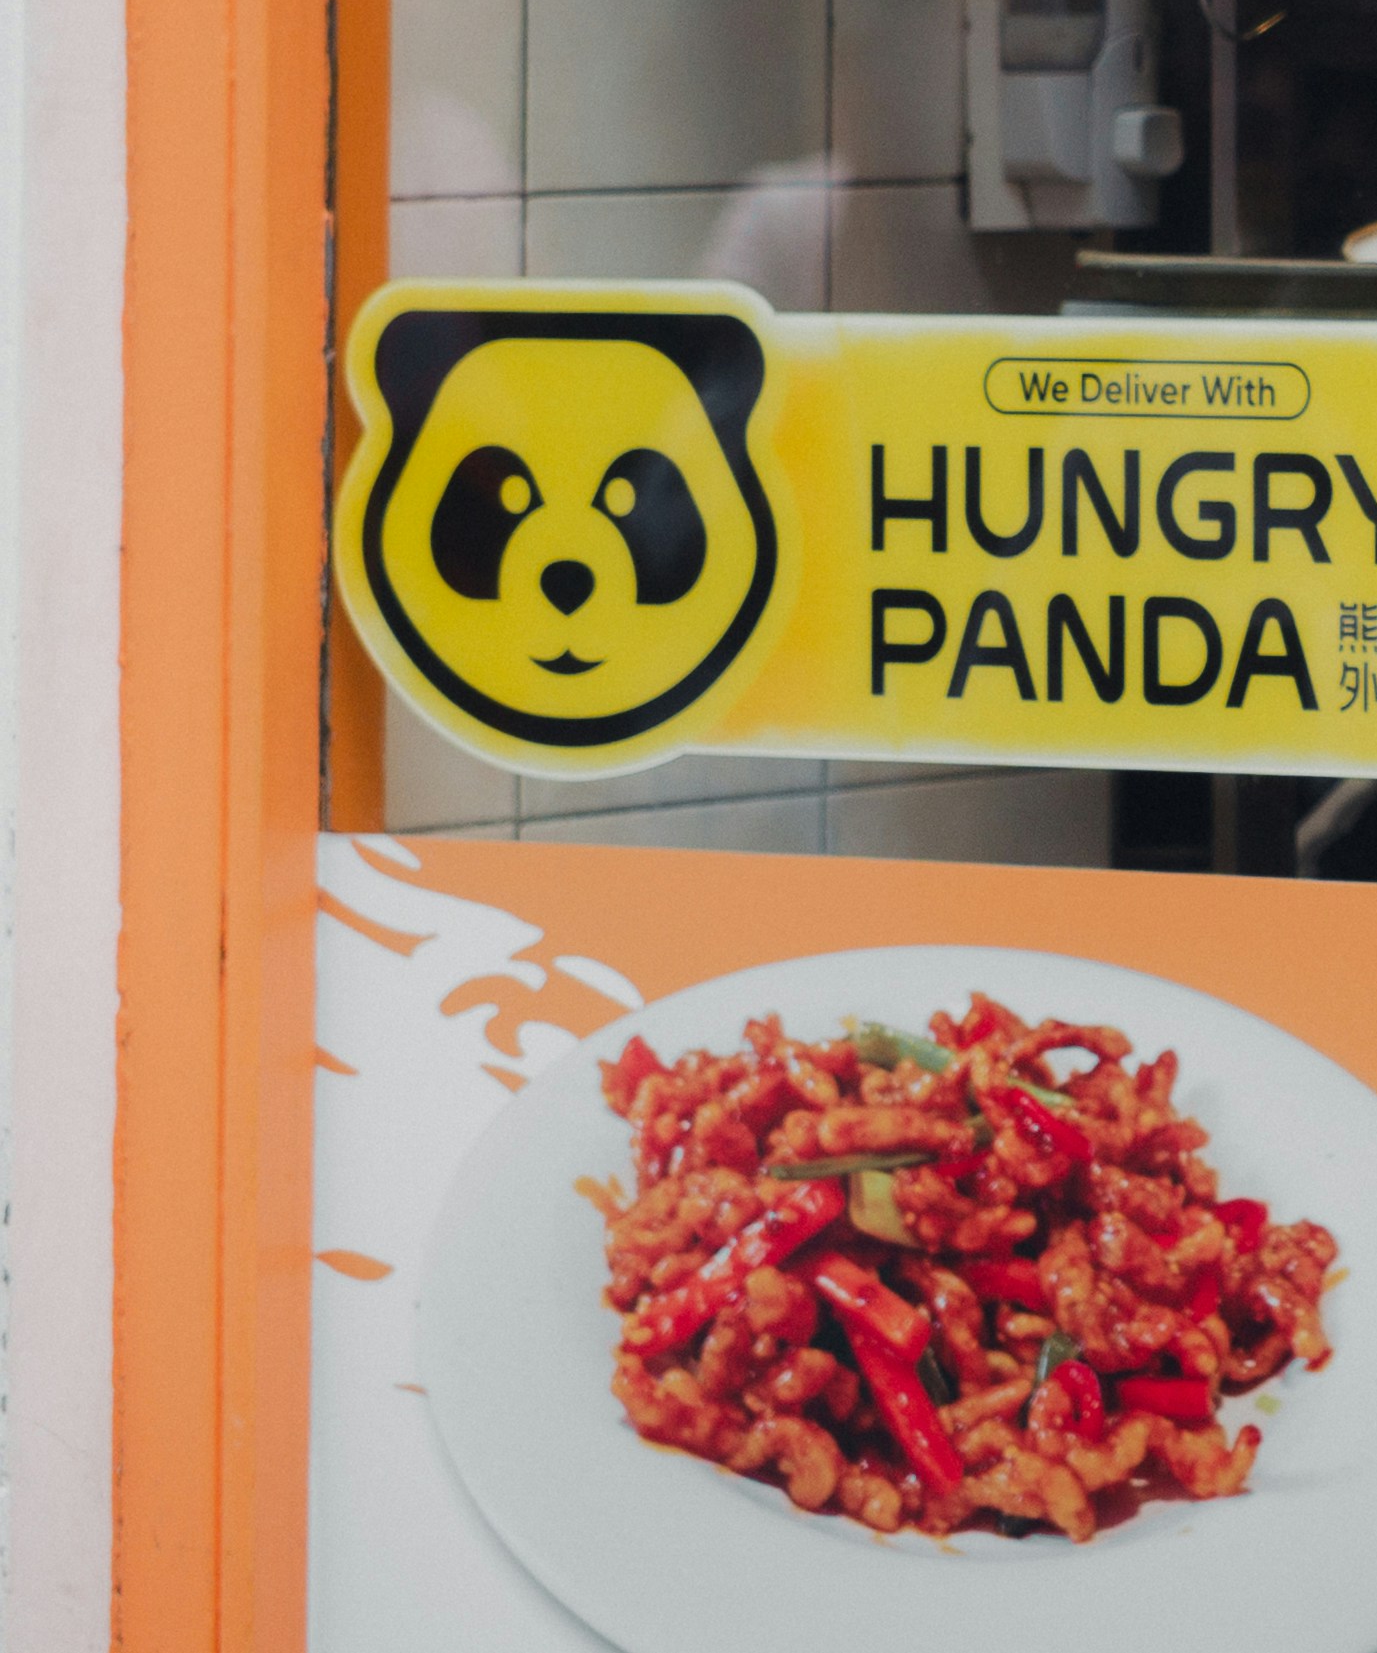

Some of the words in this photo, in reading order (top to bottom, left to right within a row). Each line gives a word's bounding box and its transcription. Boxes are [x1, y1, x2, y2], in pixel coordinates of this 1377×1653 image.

[1019, 372, 1069, 403] We
[1081, 373, 1190, 405] Deliver
[1202, 375, 1276, 407] With
[871, 588, 1319, 711] PANDA
